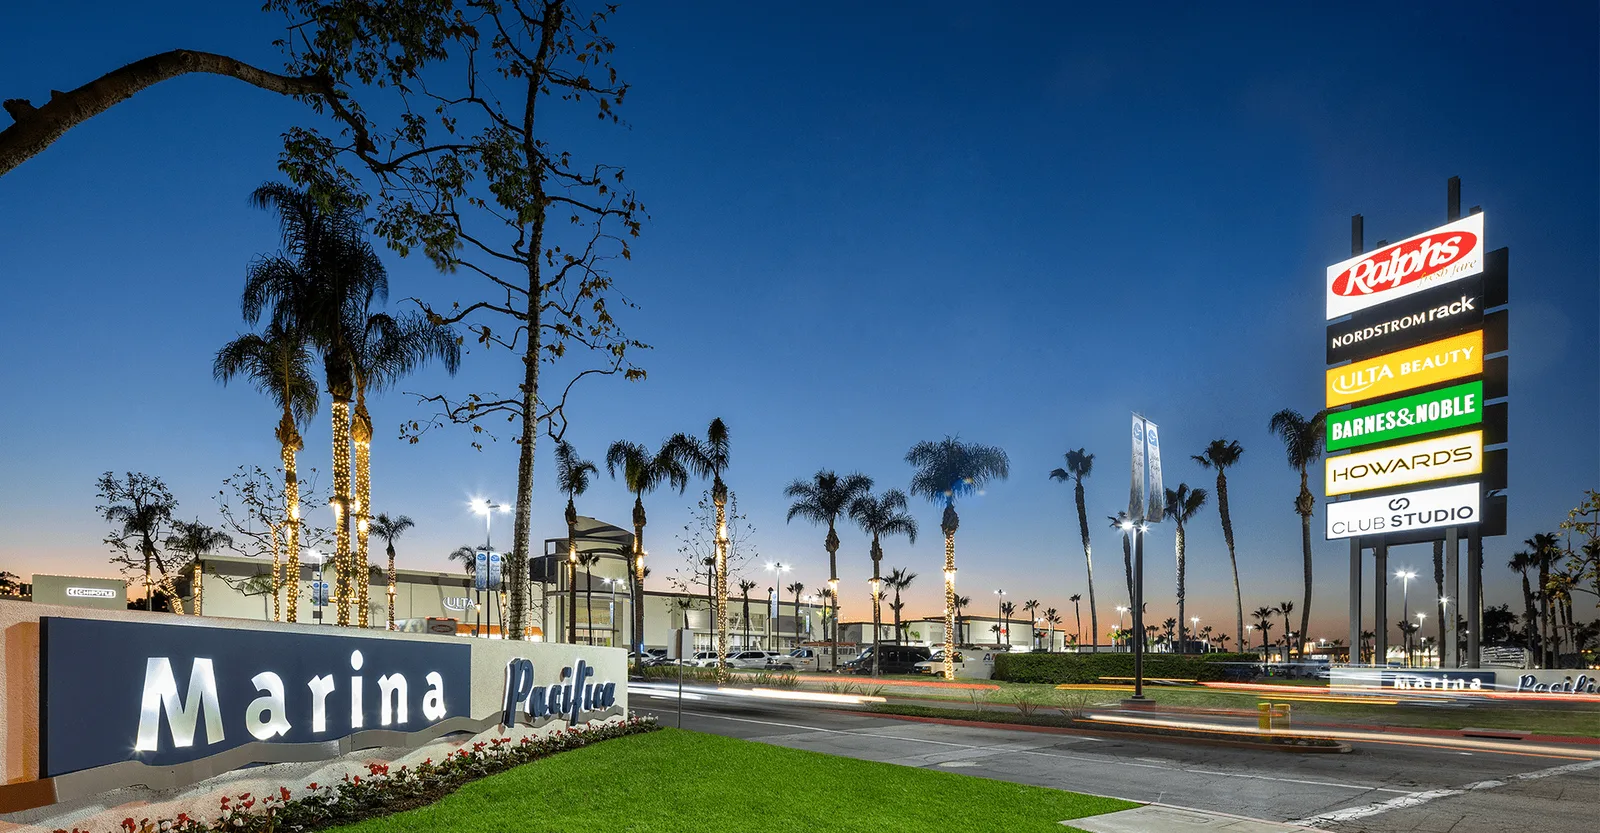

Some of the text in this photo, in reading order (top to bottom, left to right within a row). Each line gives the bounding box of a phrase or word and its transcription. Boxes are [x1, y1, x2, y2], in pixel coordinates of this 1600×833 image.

[1342, 236, 1463, 296] Ralphs
[1417, 259, 1477, 288] fresh fare
[1332, 295, 1475, 349] NORDSTROM rack
[1333, 346, 1475, 393] ULTA BEAUTY
[1332, 393, 1475, 441] BARNES&NOBLE
[1333, 446, 1473, 482] HOWARD'S
[1332, 506, 1474, 535] CLUB STUDIO
[443, 596, 476, 610] ULTA
[134, 649, 616, 751] Marina Pacifica
[1393, 673, 1482, 690] Marina
